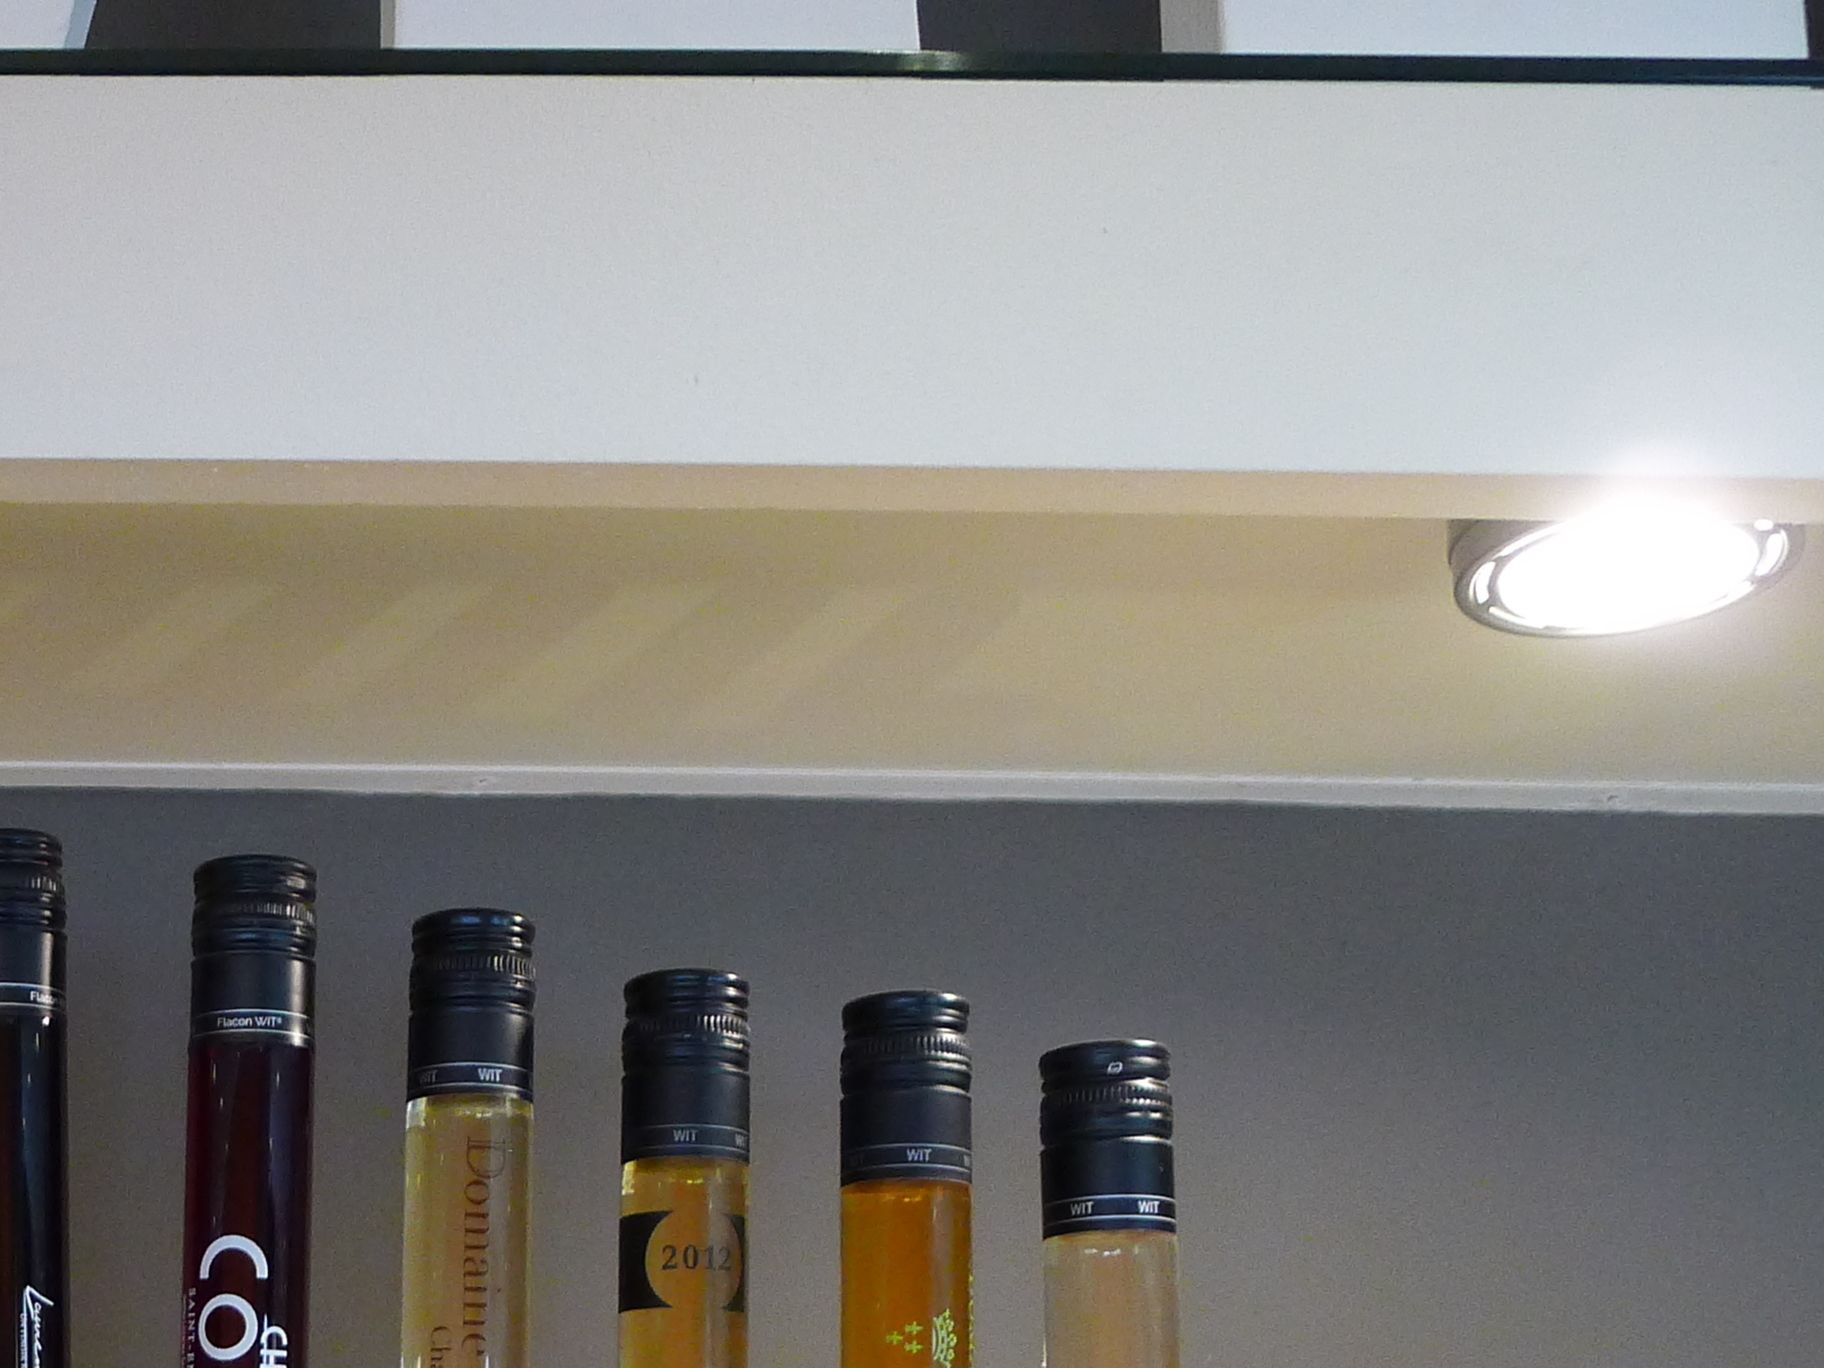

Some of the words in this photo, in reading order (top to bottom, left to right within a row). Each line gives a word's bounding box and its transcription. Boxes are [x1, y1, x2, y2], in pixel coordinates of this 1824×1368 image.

[217, 1015, 253, 1028] Flacon
[478, 1068, 502, 1082] WIT
[673, 1128, 697, 1142] WIT
[906, 1148, 932, 1162] WIT
[1070, 1200, 1094, 1216] WIT
[1138, 1200, 1160, 1214] WIT
[461, 1136, 507, 1357] Domaine
[661, 1244, 733, 1272] 2012
